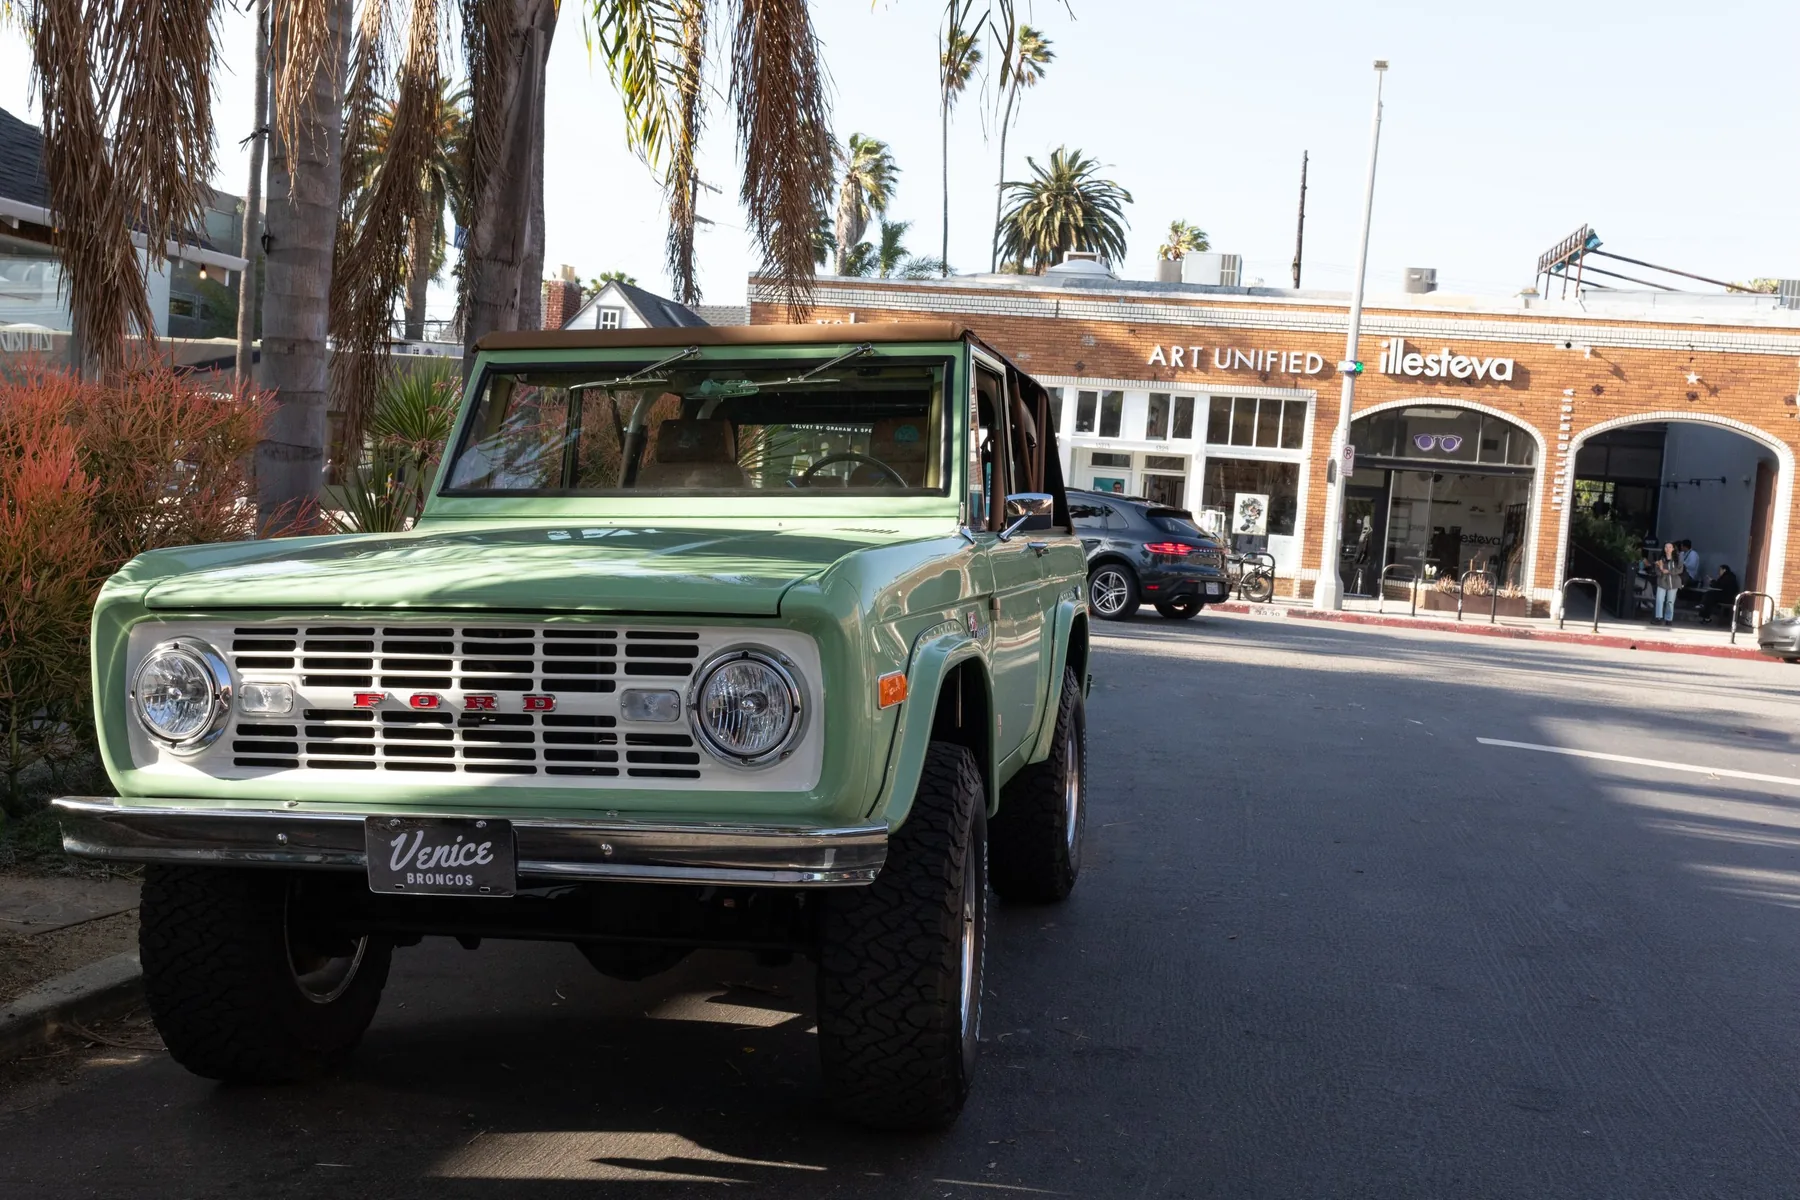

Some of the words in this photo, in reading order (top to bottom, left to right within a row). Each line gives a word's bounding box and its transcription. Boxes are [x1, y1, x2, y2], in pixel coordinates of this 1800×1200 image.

[1148, 344, 1203, 368] ART
[1214, 347, 1324, 375] UNIFIED
[1379, 338, 1514, 381] illesteva
[1551, 388, 1575, 511] INTELLIGENTSIA
[1460, 532, 1501, 546] esteva
[353, 691, 557, 712] FORD
[390, 830, 494, 872] Venice
[406, 872, 474, 887] BRONCOS
